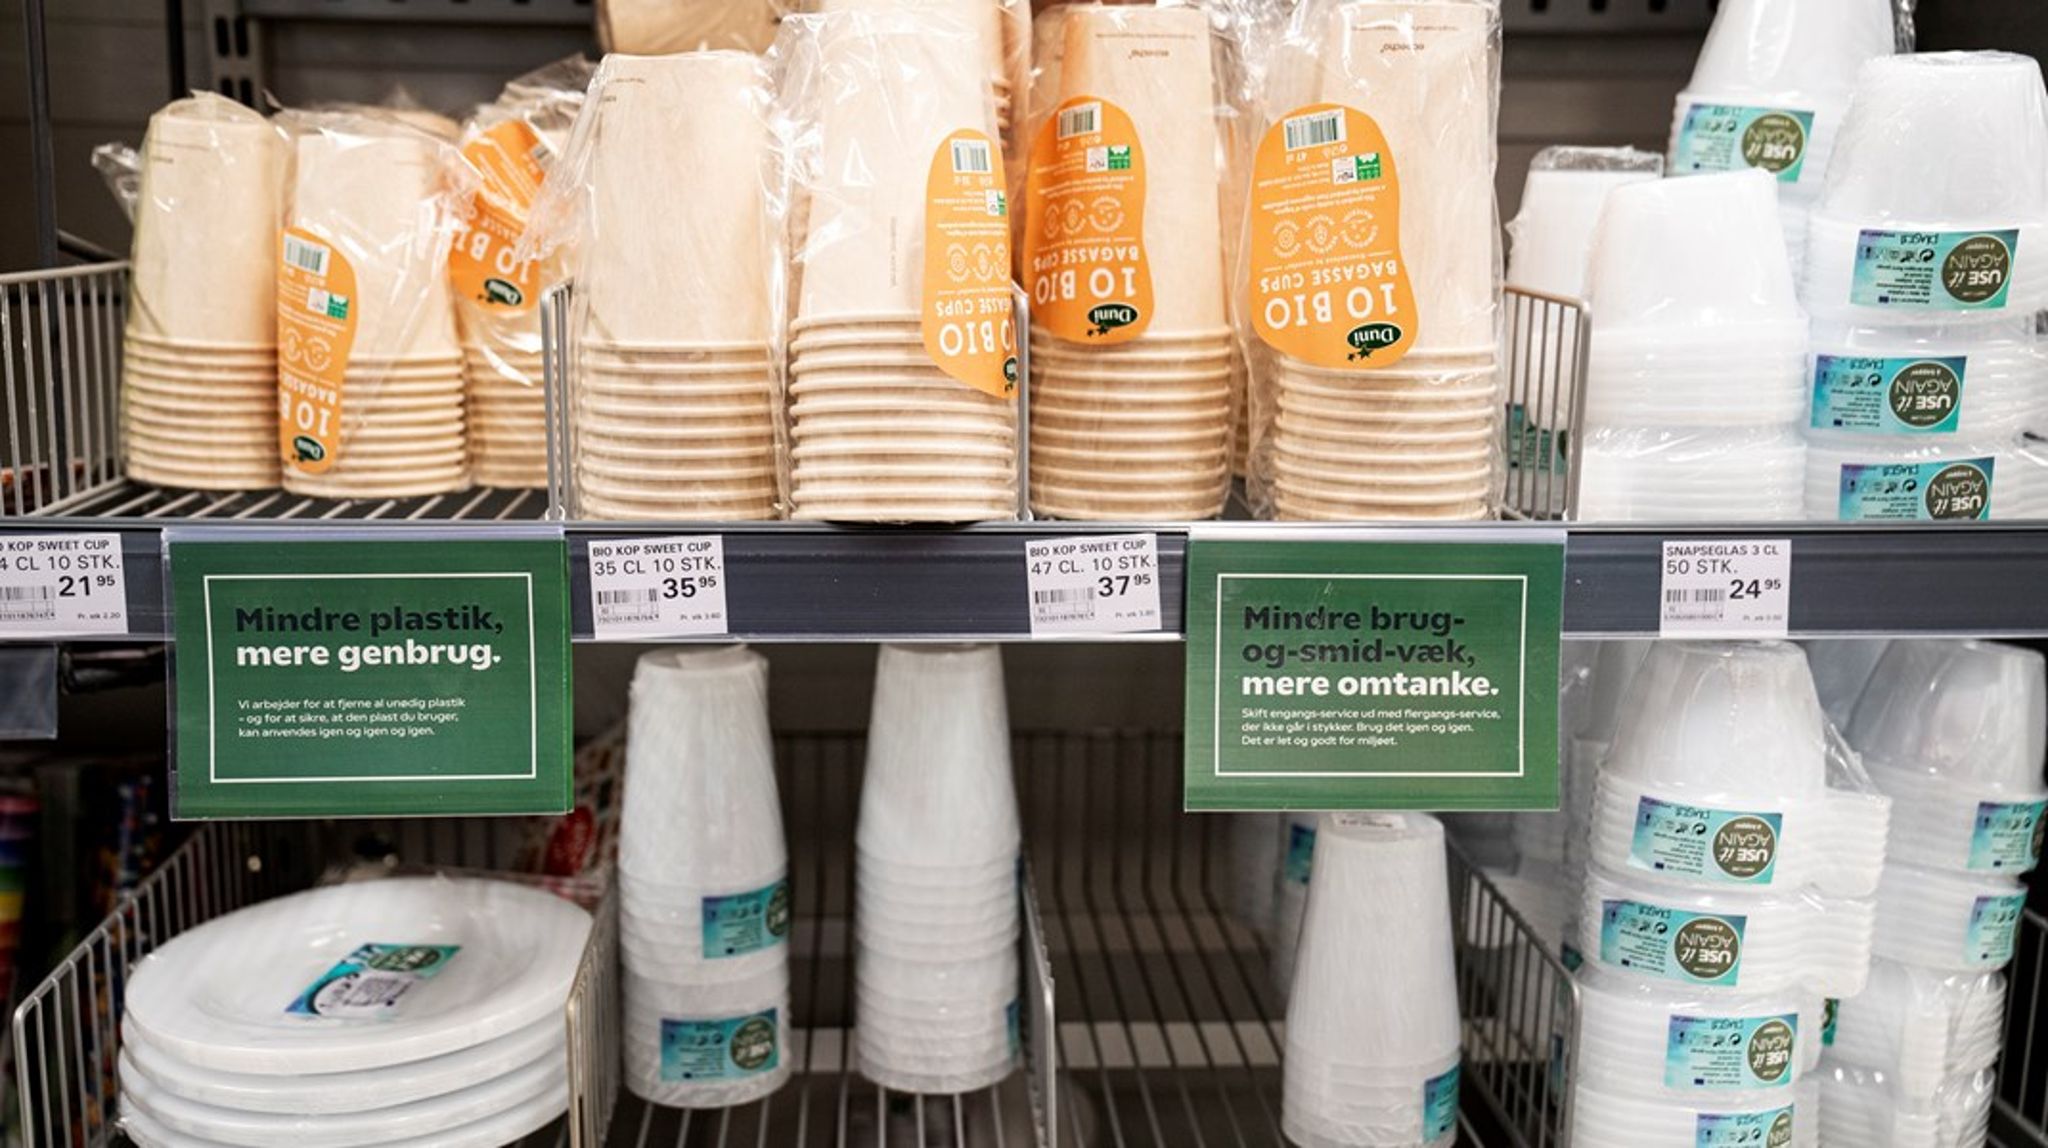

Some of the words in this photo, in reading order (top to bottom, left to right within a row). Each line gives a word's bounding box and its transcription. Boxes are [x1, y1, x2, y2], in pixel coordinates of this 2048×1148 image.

[1763, 144, 1796, 158] USE
[1062, 245, 1139, 264] BAGASSE
[1949, 254, 2004, 270] AGAIN
[1311, 259, 1398, 286] BAGASSE
[1947, 272, 1966, 288] it
[1969, 270, 2001, 285] USE
[1034, 269, 1076, 305] BIO
[1089, 267, 1136, 298] 10
[1260, 272, 1304, 294] CUPS
[935, 298, 973, 317] CUPS
[1264, 290, 1332, 329] BIO
[1346, 282, 1397, 320] 10
[1094, 308, 1131, 323] Duni
[939, 320, 995, 357] BIO
[1353, 328, 1394, 346] Duni
[1895, 378, 1953, 393] AGAIN
[1896, 397, 1913, 412] it
[1916, 395, 1951, 409] USE
[296, 401, 331, 437] 10
[1931, 480, 1983, 497] AGAIN
[1932, 498, 1949, 515] it
[1952, 495, 1982, 511] USE
[8, 541, 34, 551] KOP
[38, 541, 80, 551] SWEET
[84, 539, 110, 550] CUP
[593, 547, 612, 557] BIO
[616, 545, 640, 555] KOP
[644, 543, 683, 554] SWEET
[687, 541, 711, 552] CUP
[1030, 546, 1050, 557] BIO
[1053, 545, 1076, 555] KOP
[1079, 541, 1118, 553] SWEET
[1122, 539, 1147, 550] CUP
[1666, 545, 1748, 557] SNAPSEGLAS
[1752, 545, 1760, 556] 3
[1763, 545, 1779, 555] CL
[15, 556, 40, 571] CL
[48, 555, 71, 570] 10
[77, 554, 120, 569] STK.
[594, 560, 617, 576] 35
[623, 560, 645, 574] CL
[654, 558, 674, 573] 10
[681, 556, 721, 572] STK.
[1031, 561, 1052, 575] 47
[1058, 559, 1084, 574] CL.
[1093, 557, 1113, 571] 10
[1118, 555, 1156, 570] STK.
[1666, 559, 1690, 574] 50
[1697, 559, 1738, 574] STK.
[59, 576, 90, 597] 21
[96, 575, 115, 586] 95
[662, 577, 696, 599] 35
[698, 576, 717, 588] 95
[1098, 575, 1130, 597] 37
[1134, 574, 1151, 586] 95
[1729, 578, 1761, 600] 24
[1764, 579, 1781, 590] 95
[235, 606, 361, 632] Mindre
[371, 605, 503, 638] plastik,
[1244, 606, 1361, 631] Mindre
[1371, 606, 1465, 637] brug-
[236, 645, 330, 667] mere
[338, 638, 501, 672] genbrug.
[1242, 639, 1476, 669] og-smid-væk,
[1242, 675, 1330, 696] mere
[1337, 670, 1499, 697] omtanke.
[238, 700, 249, 709] Vi
[252, 699, 300, 711] arbejder
[303, 699, 320, 709] for
[323, 699, 336, 709] at
[338, 698, 372, 711] fjerne
[373, 699, 384, 708] al
[386, 698, 425, 711] unødig
[428, 697, 466, 710] plastik
[246, 715, 262, 725] og
[264, 714, 282, 723] for
[284, 714, 296, 722] at
[298, 713, 329, 723] sikre,
[331, 713, 344, 722] at
[346, 712, 368, 722] den
[370, 712, 398, 724] plast
[400, 712, 416, 721] du
[1241, 708, 1268, 718] Skift
[1270, 709, 1359, 720] engangs-service
[1361, 708, 1376, 718] ud
[1378, 708, 1402, 718] med
[1404, 708, 1502, 720] flergangs-service,
[239, 727, 260, 737] kan
[262, 727, 317, 736] anvendes
[319, 726, 344, 738] igen
[346, 728, 361, 738] og
[364, 726, 388, 738] igen
[390, 728, 406, 738] og
[408, 726, 435, 738] igen.
[1241, 722, 1260, 732] der
[1263, 722, 1285, 732] ikke
[1287, 722, 1305, 734] går
[1313, 722, 1355, 734] stykker.
[1357, 722, 1382, 734] Brug
[1386, 722, 1404, 732] det
[1406, 722, 1429, 734] igen
[1431, 725, 1446, 734] og
[1448, 722, 1474, 734] igen.
[1242, 736, 1261, 746] Det
[1263, 738, 1276, 746] er
[1277, 736, 1292, 746] let
[1294, 738, 1308, 748] og
[1310, 736, 1337, 748] godt
[1339, 735, 1356, 745] for
[1357, 735, 1398, 748] miljøet.
[1719, 832, 1771, 847] AGAIN
[1718, 848, 1735, 864] it
[1737, 849, 1769, 862] USE
[1680, 932, 1734, 949] AGAIN
[1679, 947, 1697, 963] it
[1699, 948, 1732, 963] USE
[1752, 1036, 1790, 1051] AGAIN
[1766, 1051, 1789, 1065] USE
